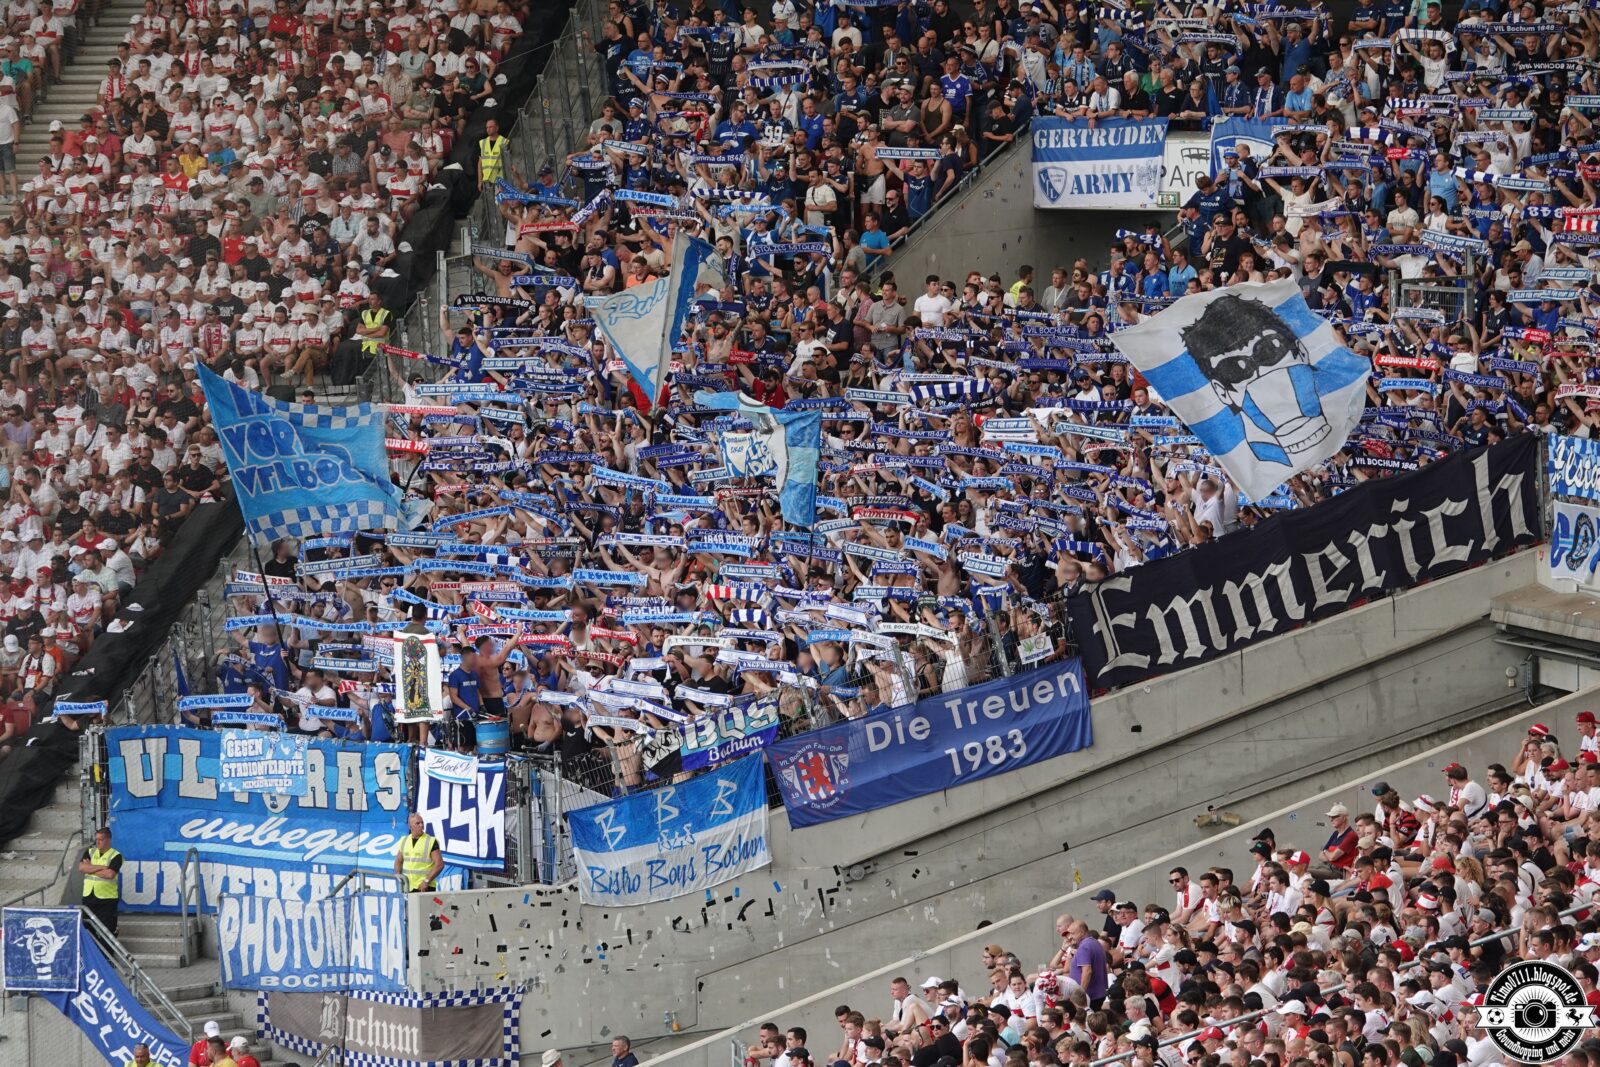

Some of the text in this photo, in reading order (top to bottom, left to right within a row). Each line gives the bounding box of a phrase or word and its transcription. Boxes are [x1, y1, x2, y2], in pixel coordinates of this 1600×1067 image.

[1537, 24, 1555, 32] 1848
[1533, 61, 1564, 70] BOCHUM
[1034, 123, 1168, 150] GERTRUDEN
[727, 153, 744, 162] 1848
[1070, 172, 1134, 195] ARMY
[1567, 234, 1599, 242] BOCHUM
[756, 243, 822, 254] STOLZES MITGLIED
[475, 296, 511, 304] BOCHUM
[512, 299, 530, 307] 1848
[943, 327, 970, 335] Bochum
[1039, 327, 1070, 335] BOCHUM
[1492, 359, 1517, 370] STOLZES
[1446, 370, 1456, 380] VfL
[1457, 374, 1488, 387] BOCHUM
[875, 424, 945, 438] VfL BOCHUM 1848
[1411, 430, 1449, 445] VfL BOCHUM
[384, 437, 411, 450] KURVE
[847, 440, 875, 449] BOCHUM
[423, 462, 449, 470] FUCK
[875, 455, 887, 463] VfL
[925, 457, 943, 466] 1848
[1355, 457, 1366, 465] VfL
[1367, 458, 1400, 468] BOCHUM
[233, 458, 300, 498] VFL
[866, 495, 907, 505] BOCHUM
[1069, 487, 1095, 500] BOCHUM
[1000, 515, 1034, 532] BOCHUM
[1125, 519, 1167, 531] BOCHUM
[704, 536, 725, 544] 1848
[820, 549, 837, 559] 1848
[1093, 453, 1534, 680] Emmerich
[589, 573, 631, 581] BOCHUM
[652, 707, 675, 720] BOCHUM
[865, 669, 1081, 752] Die Treuen
[226, 737, 264, 758] GEGEN
[708, 737, 764, 762] Bochum
[789, 744, 812, 763] Bochum
[944, 728, 1027, 776] 1983
[119, 736, 402, 812] ULRAS
[653, 786, 680, 826] B
[710, 779, 737, 820] B
[595, 807, 626, 851] B
[180, 817, 403, 862] unbeque
[587, 833, 766, 896] Bistro Boys Bochum
[219, 892, 407, 984] PHOTOMAFIA
[259, 972, 374, 988] BOCHUM
[85, 969, 182, 1067] ALARMSTUFE
